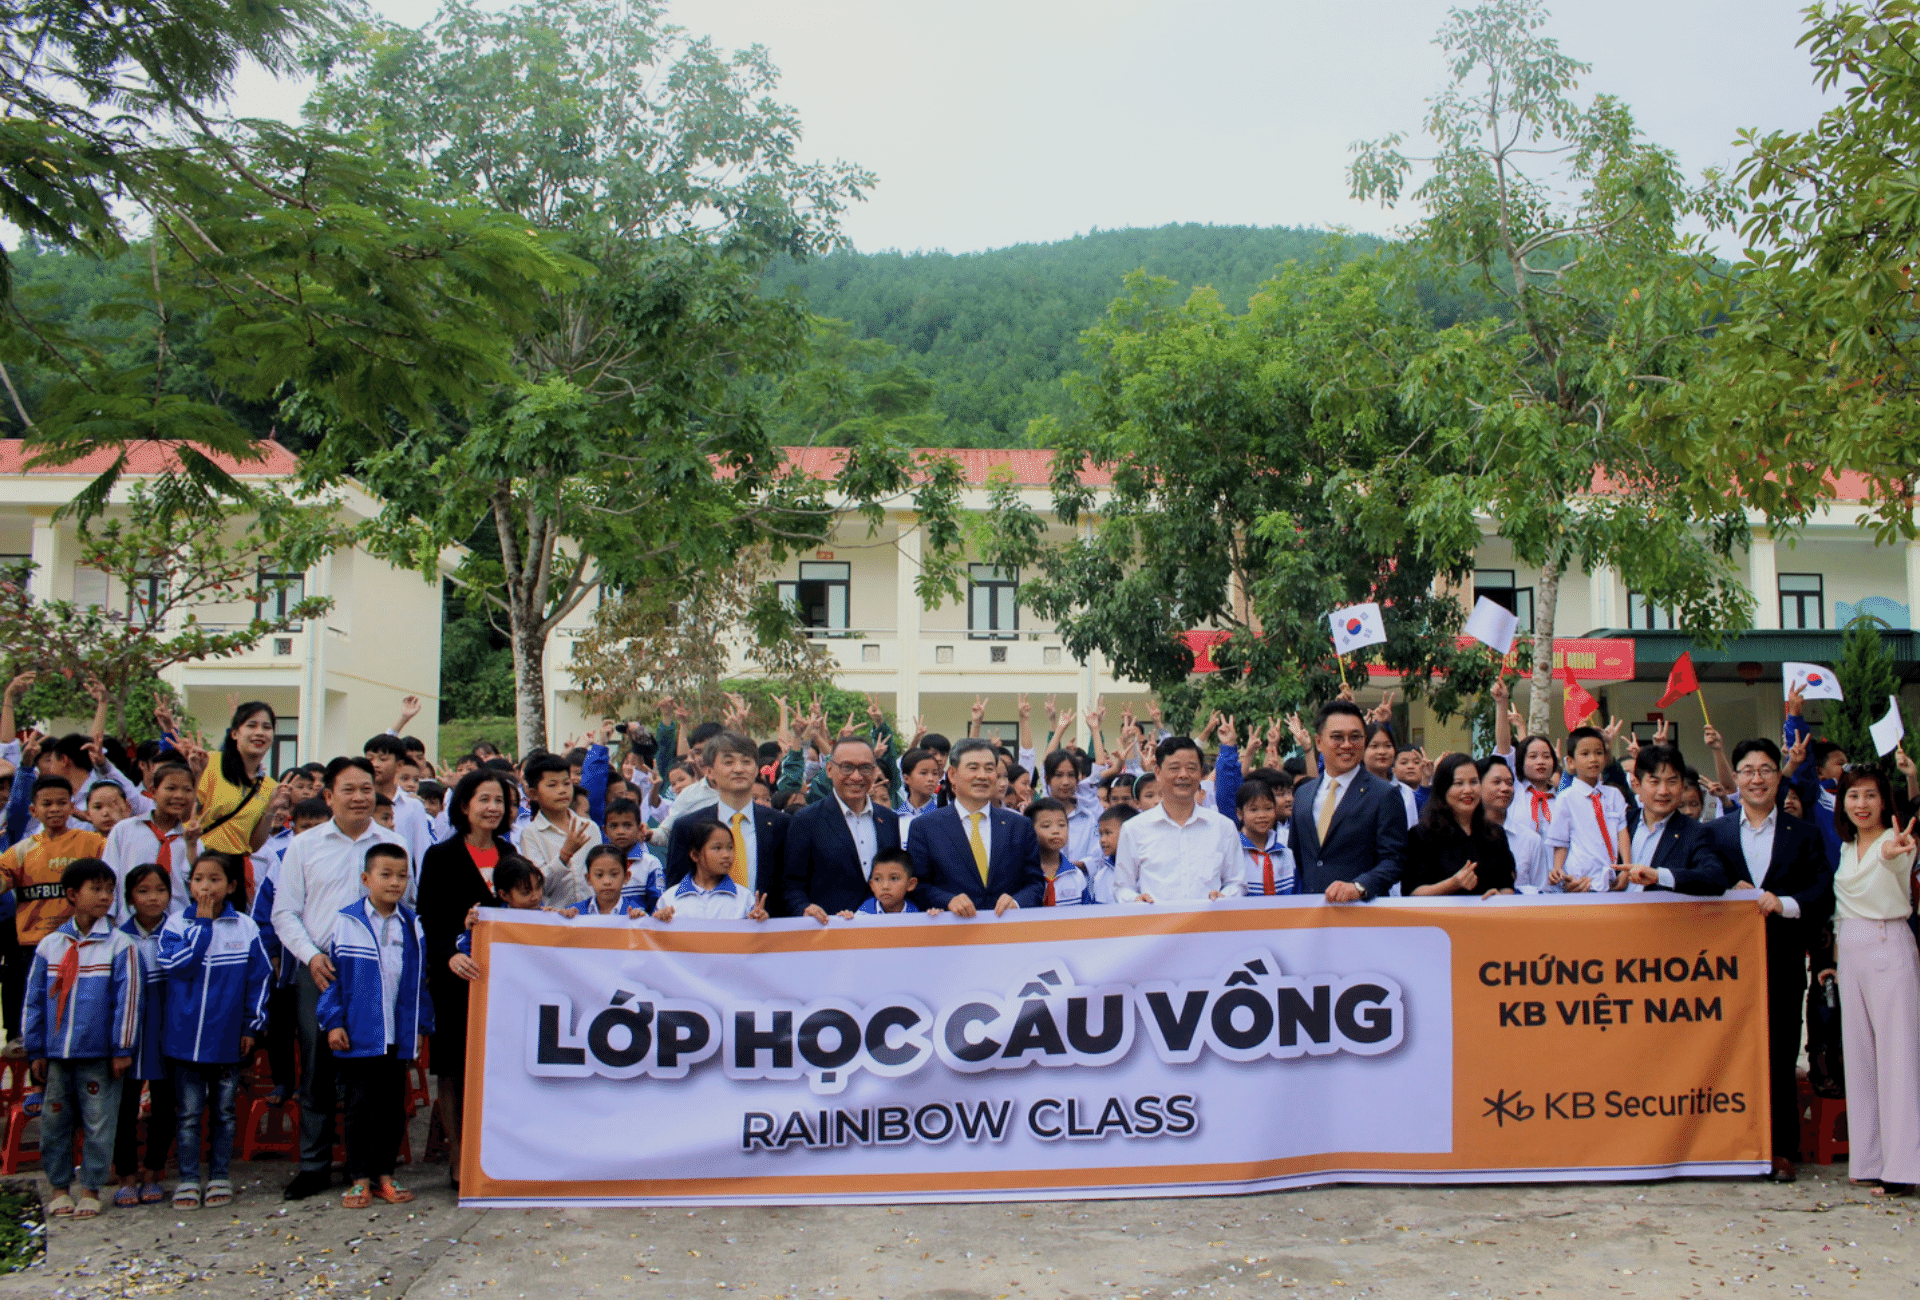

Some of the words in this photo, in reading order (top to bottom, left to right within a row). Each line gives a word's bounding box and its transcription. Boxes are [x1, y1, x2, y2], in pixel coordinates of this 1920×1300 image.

[1478, 953, 1604, 987] CHỨNG
[1616, 949, 1739, 983] KHOÁN
[537, 989, 709, 1069] LỚP
[734, 1004, 922, 1084] HỌC
[944, 968, 1124, 1063] CẦU
[1146, 958, 1392, 1050] VỒNG
[1499, 1001, 1547, 1027] KB
[1556, 992, 1634, 1032] VIỆT
[1644, 996, 1722, 1024] NAM
[742, 1099, 1012, 1149] RAINBOW
[1028, 1095, 1196, 1137] CLASS
[1545, 1091, 1596, 1120] KB
[1604, 1087, 1747, 1118] Securities
